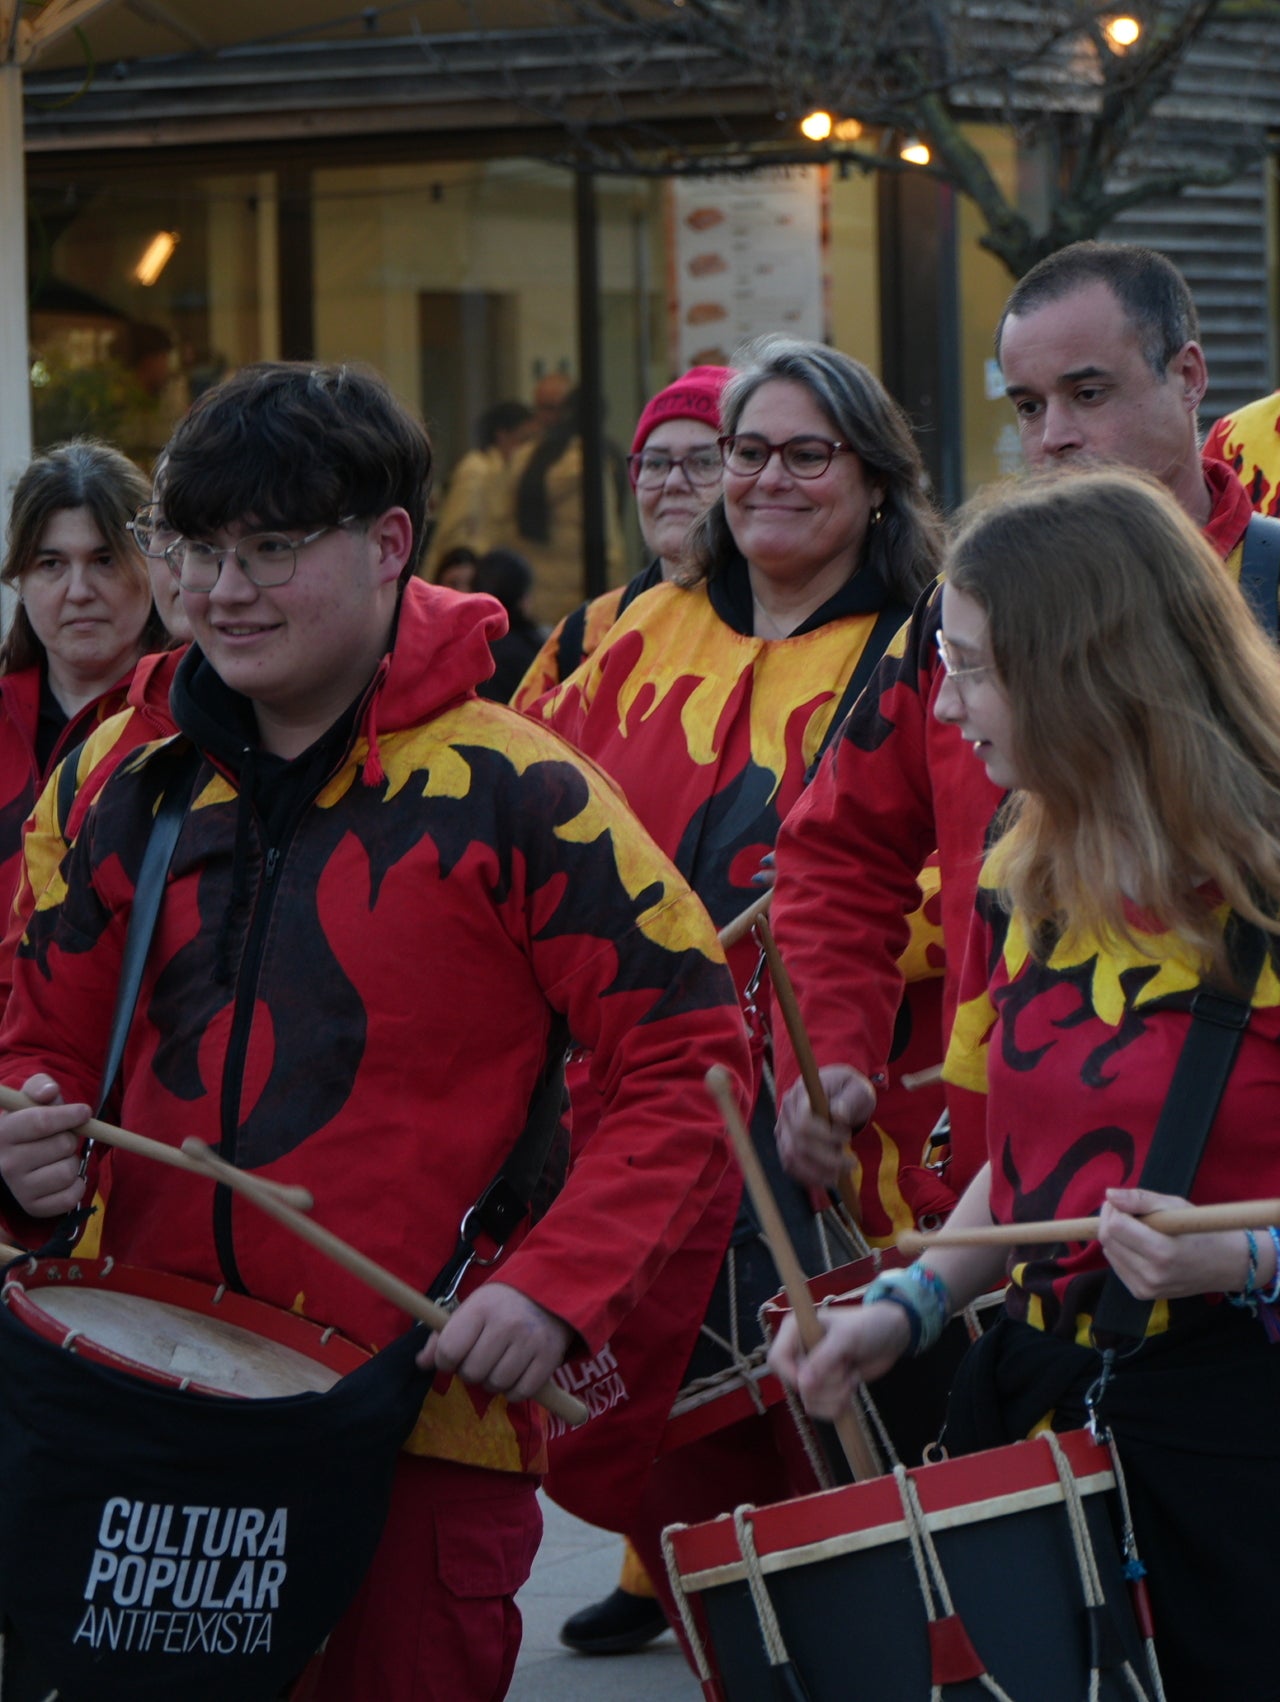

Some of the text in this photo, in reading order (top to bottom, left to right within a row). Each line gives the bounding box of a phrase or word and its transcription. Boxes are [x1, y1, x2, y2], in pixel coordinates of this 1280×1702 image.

[98, 1496, 288, 1557] CULTURA
[84, 1549, 287, 1609] POPULAR
[73, 1604, 273, 1653] ANTIFEIXISTA
